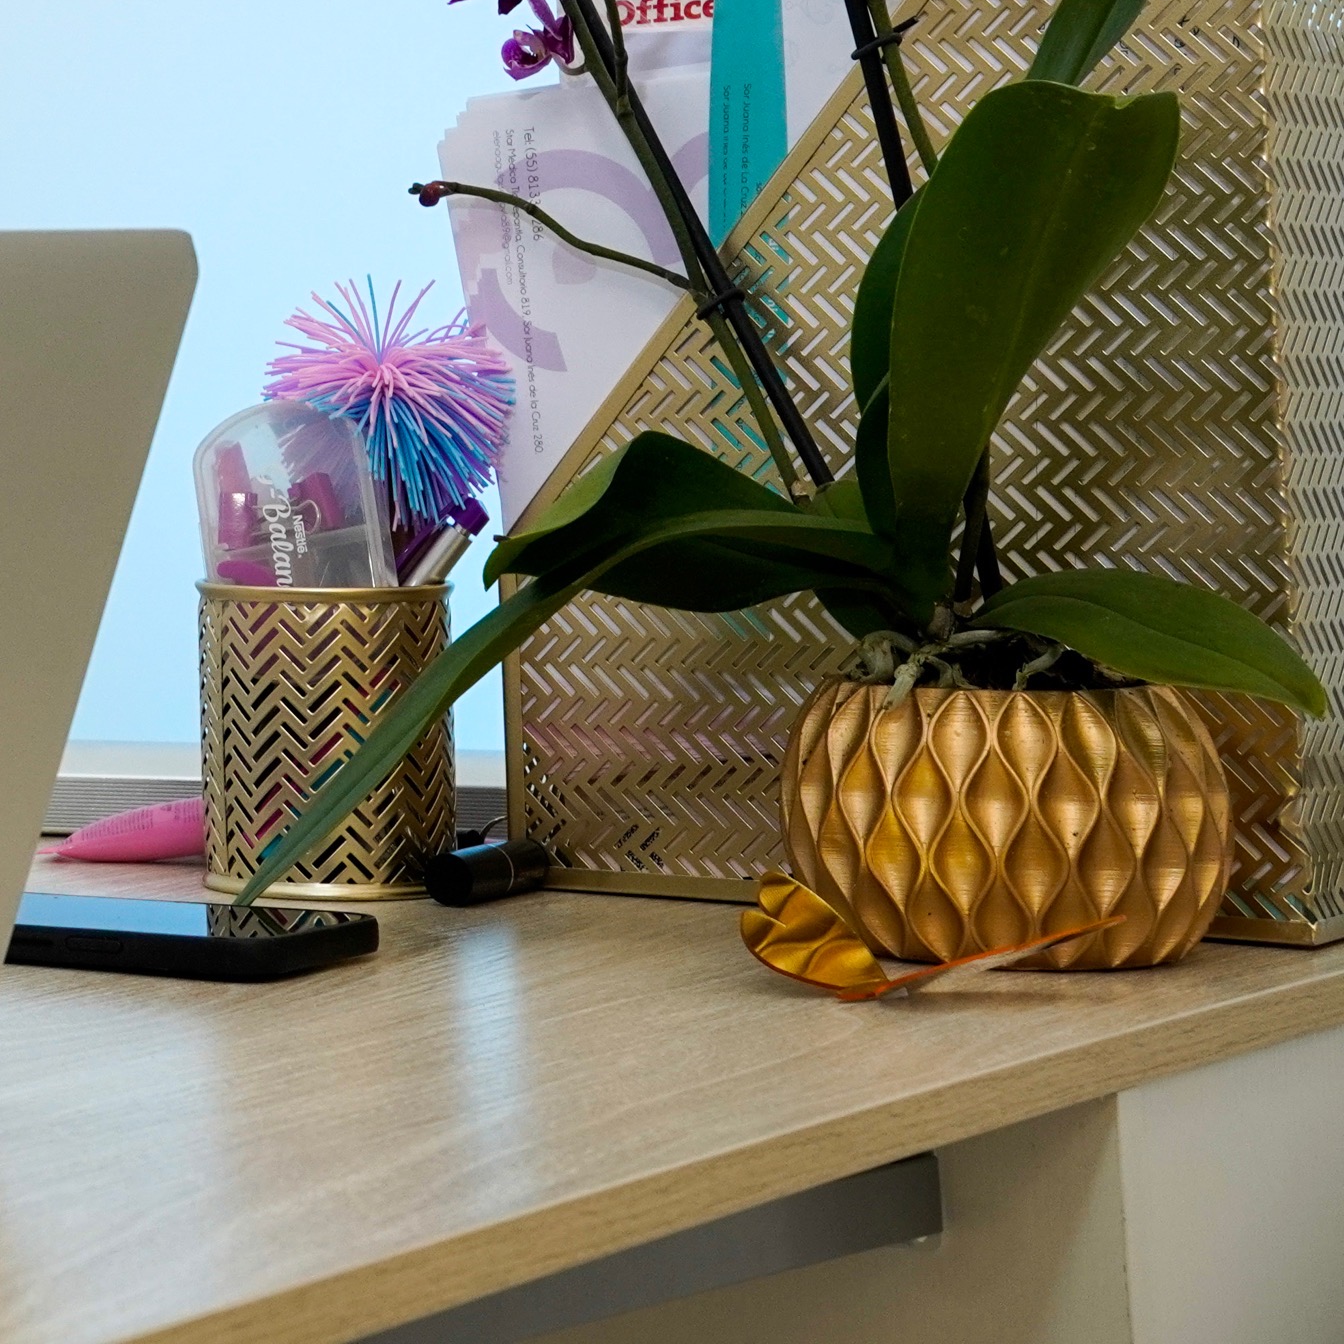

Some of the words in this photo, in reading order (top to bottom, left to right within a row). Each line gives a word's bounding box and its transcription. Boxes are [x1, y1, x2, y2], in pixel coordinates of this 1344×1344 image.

[743, 83, 751, 100] Sor
[742, 102, 751, 132] Juana
[741, 134, 750, 154] Inés
[525, 147, 539, 172] (55)
[741, 156, 750, 169] de
[740, 172, 748, 184] La
[740, 186, 749, 209] Cruz
[516, 245, 527, 296] Consultorio
[523, 320, 532, 335] Sor
[529, 384, 537, 398] de
[531, 400, 539, 409] la
[532, 411, 541, 431] Cruz
